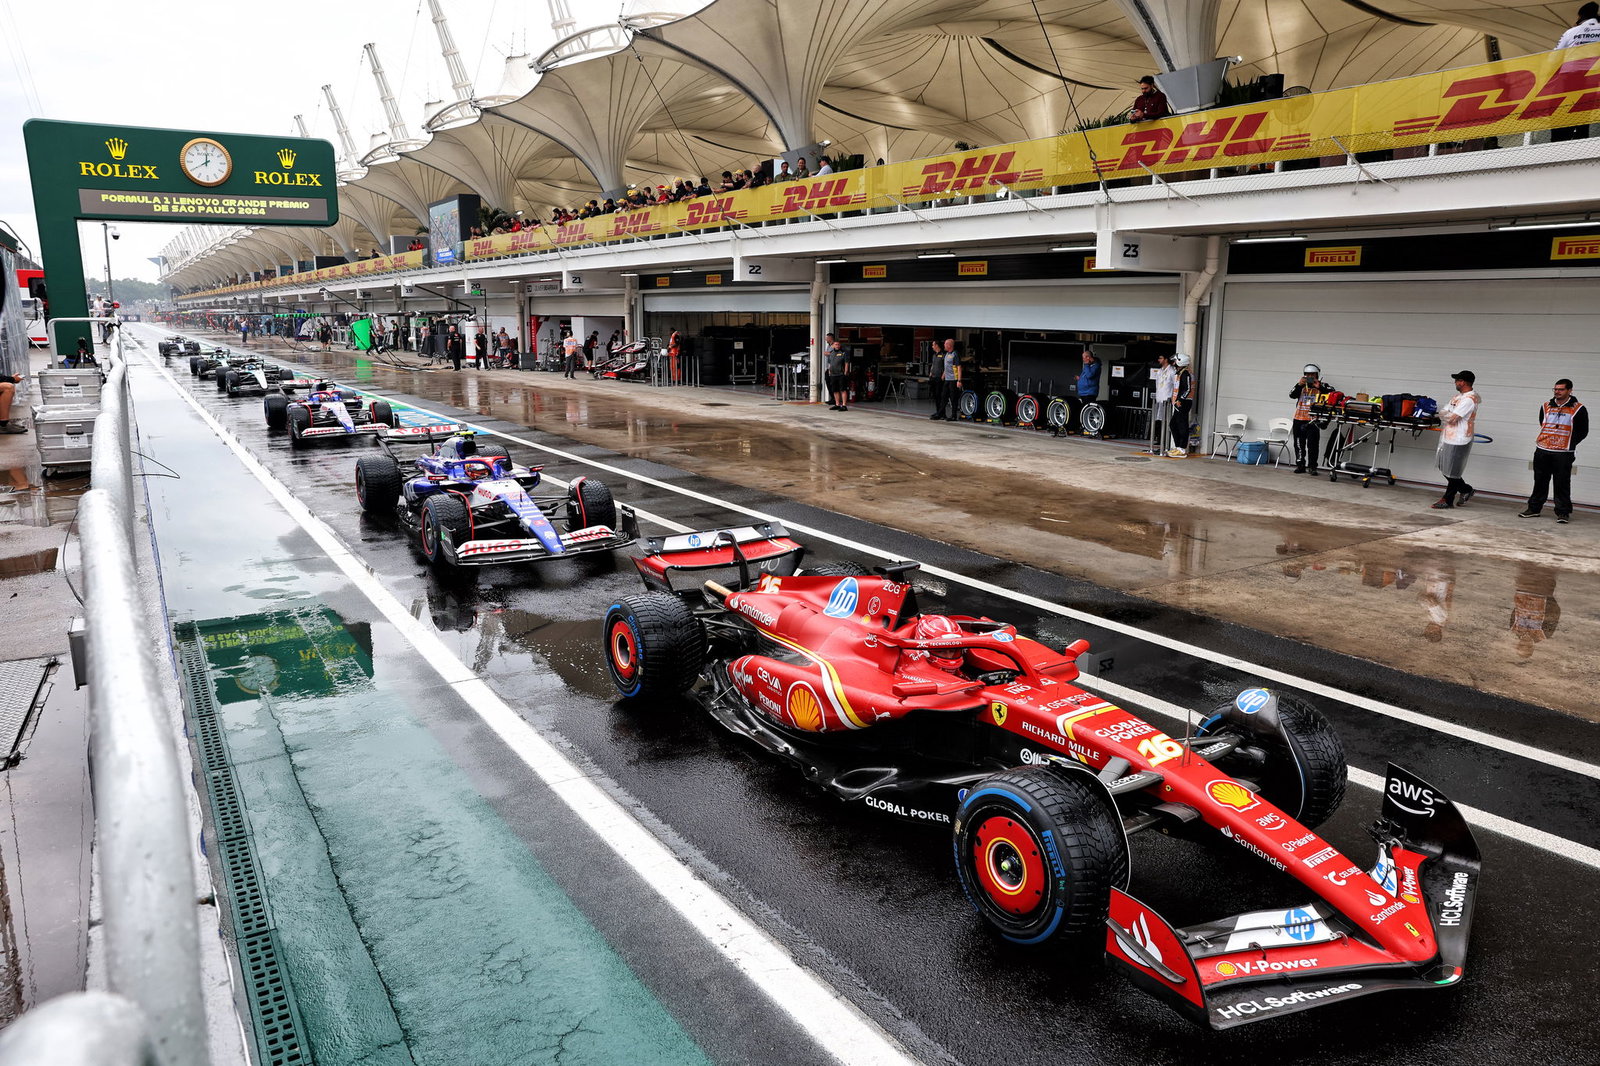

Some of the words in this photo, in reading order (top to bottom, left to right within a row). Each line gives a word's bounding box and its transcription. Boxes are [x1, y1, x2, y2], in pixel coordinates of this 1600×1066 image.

[1435, 57, 1600, 132] DH
[1117, 112, 1276, 171] DHL
[79, 161, 160, 180] ROLEX
[254, 171, 323, 187] ROLEX
[918, 151, 1021, 195] DHL
[101, 194, 161, 204] FORMULA
[173, 197, 219, 207] LENOVO
[222, 199, 267, 208] GRANDE
[783, 178, 853, 214] DHL
[198, 206, 236, 214] PAULO
[686, 197, 737, 226] DHL
[555, 222, 587, 244] DHL
[613, 211, 653, 236] DHL
[1123, 243, 1139, 258] 23
[1309, 250, 1356, 264] PIRELLI
[1557, 239, 1600, 256] PIRE
[749, 265, 761, 274] 22
[960, 262, 986, 275] PIRELLI
[411, 425, 451, 434] ORLEN
[571, 527, 611, 542] HUGO
[689, 534, 701, 547] hp
[464, 540, 522, 555] HUGO
[830, 578, 857, 617] hp
[882, 581, 901, 595] ZCG
[739, 600, 776, 627] Santander
[1047, 692, 1098, 709] GENESY
[1239, 689, 1267, 712] hp
[1094, 718, 1148, 737] GLOBAL
[1109, 725, 1157, 742] POKER
[1022, 721, 1066, 746] RICHARD
[1068, 740, 1100, 761] MILLE
[1137, 733, 1185, 768] 16
[1389, 777, 1435, 806] aws
[864, 796, 908, 816] GLOBAL
[910, 809, 950, 824] POKER
[1255, 813, 1281, 827] aws
[1041, 829, 1066, 878] PIRELLI
[1233, 833, 1288, 872] Santander
[1302, 846, 1340, 868] PIRELLI
[1403, 866, 1418, 895] V-Power
[1439, 871, 1469, 926] HCLSoftware
[1287, 908, 1313, 940] hp
[1370, 901, 1407, 925] Santande
[1236, 955, 1319, 974] V-Power
[1216, 981, 1364, 1019] HCLSoftware
